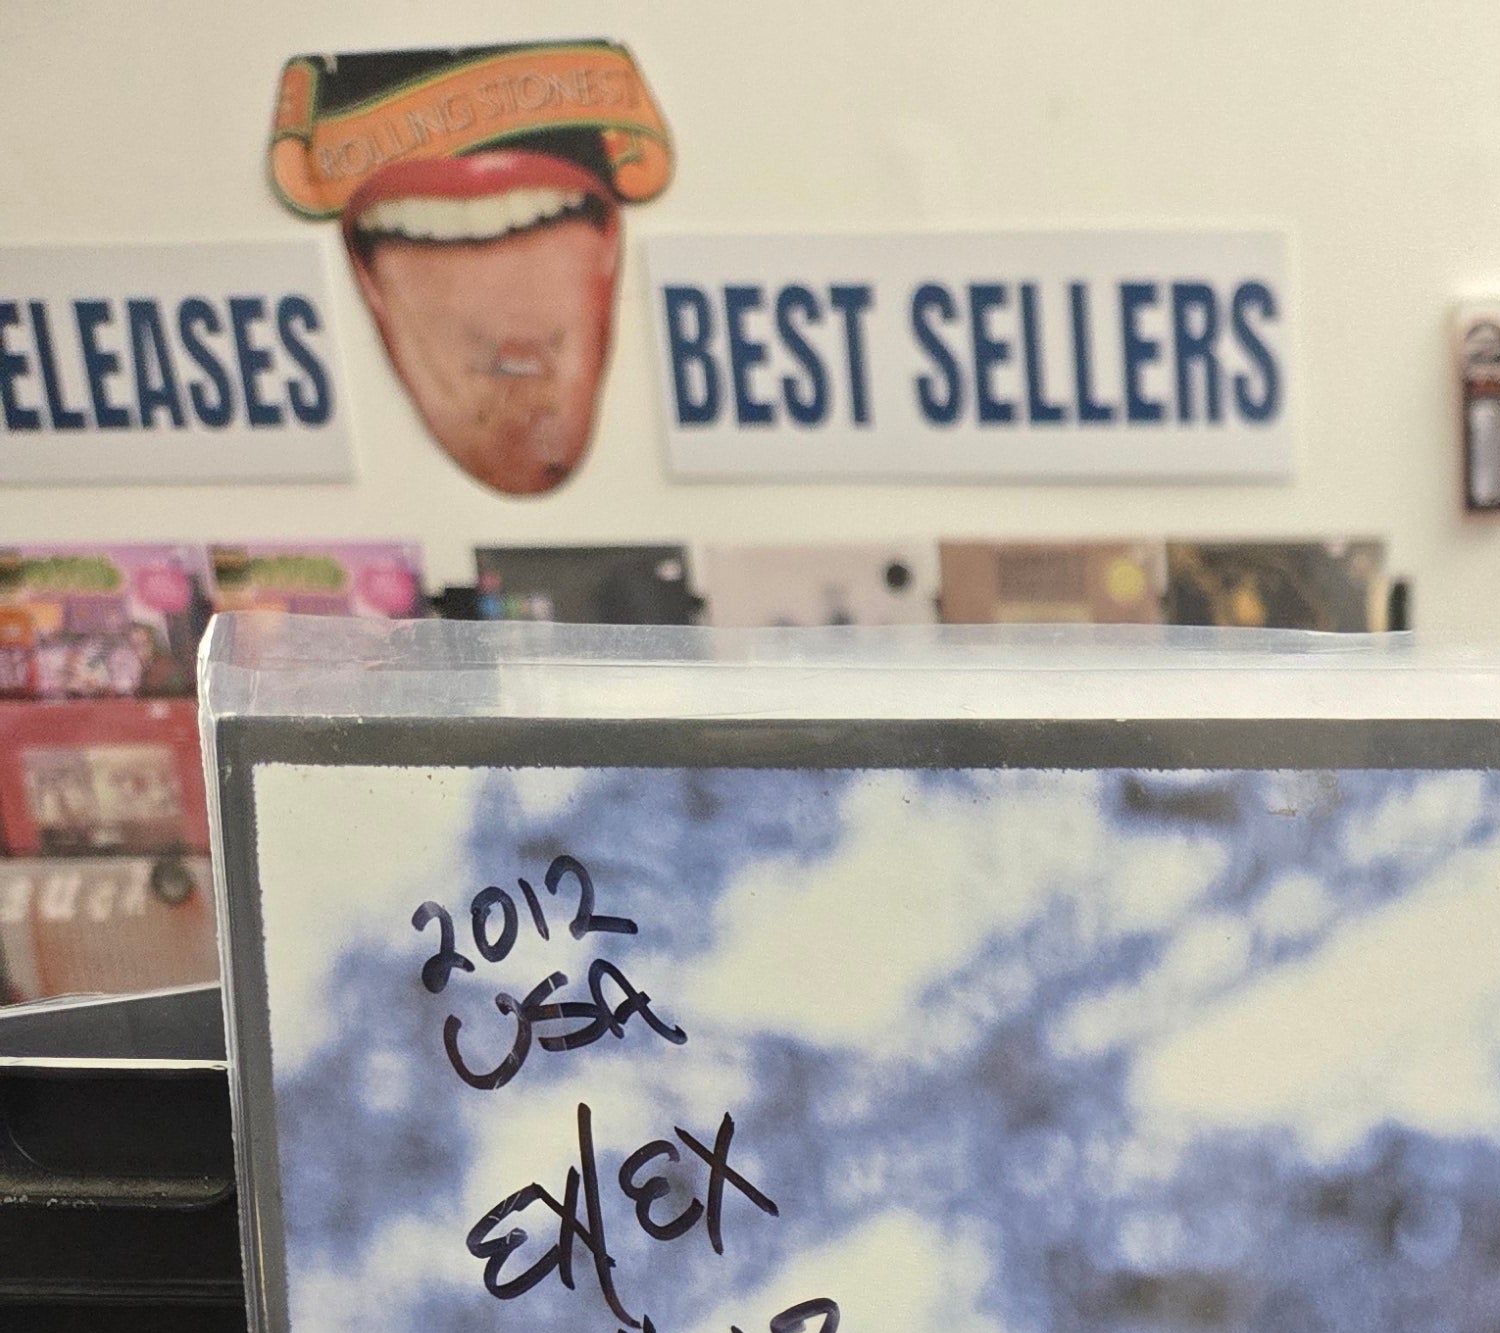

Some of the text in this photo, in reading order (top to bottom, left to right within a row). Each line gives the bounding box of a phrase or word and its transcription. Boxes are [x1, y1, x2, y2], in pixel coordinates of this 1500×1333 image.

[317, 66, 640, 178] ROLLING STONES
[663, 283, 1282, 427] BEST SELLERS
[411, 855, 638, 993] 2012
[444, 958, 687, 1090] USA
[466, 1103, 780, 1329] EX/EX
